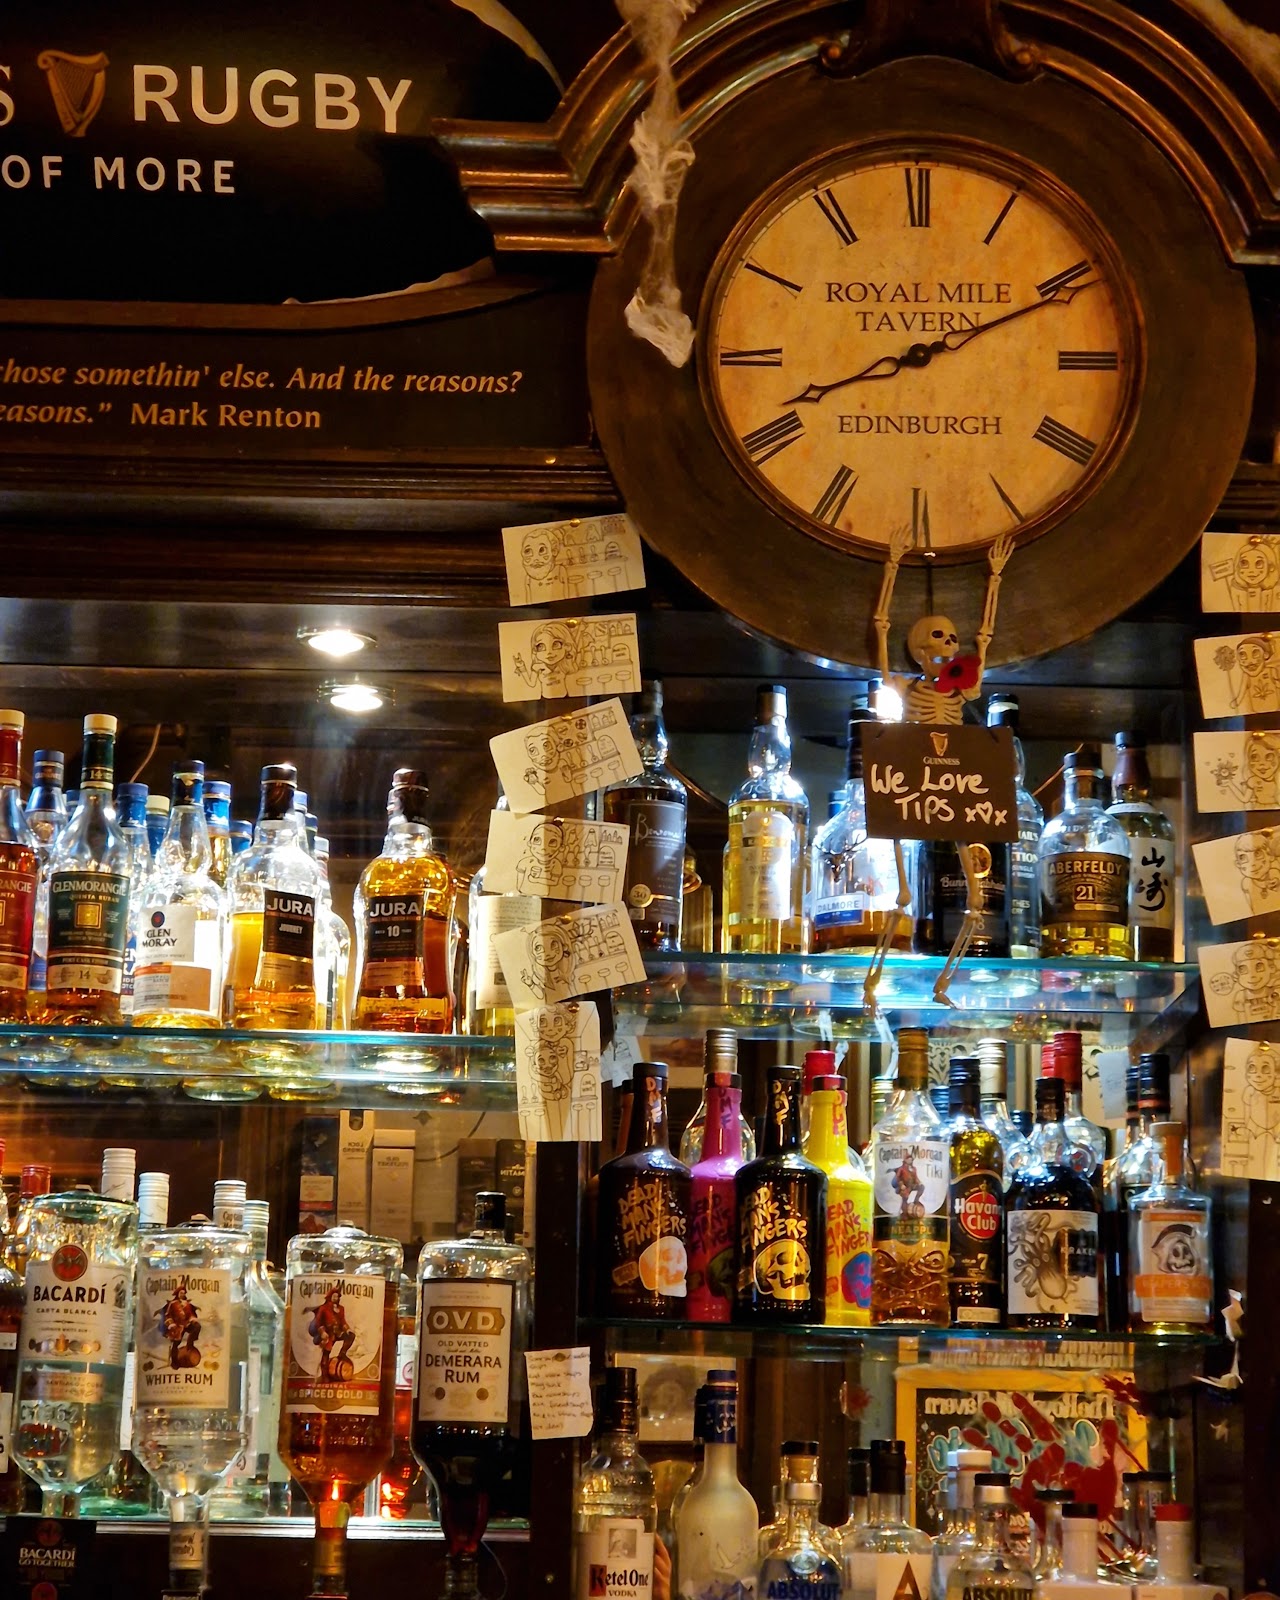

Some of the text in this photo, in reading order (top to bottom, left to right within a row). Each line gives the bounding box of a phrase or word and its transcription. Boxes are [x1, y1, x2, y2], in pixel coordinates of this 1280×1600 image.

[133, 64, 413, 134] RUGBY
[1, 154, 236, 194] OF MORE
[825, 281, 1013, 305] ROYAL MILE
[855, 311, 982, 333] TAVERN
[0, 358, 523, 395] hose somethin' else. And the reasons?
[131, 402, 208, 427] Mark
[218, 404, 322, 429] Renton
[837, 414, 1003, 436] EDINBURGH
[870, 763, 990, 795] We Love
[894, 791, 956, 825] TIPS
[1049, 860, 1122, 876] ABERFELDY
[53, 880, 128, 897] GLENMORANGIE
[1076, 885, 1096, 901] 21
[266, 898, 313, 917] JURA
[370, 901, 422, 917] JURA
[817, 899, 860, 914] DALMORE
[146, 928, 172, 939] GLEN
[387, 925, 400, 938] 10
[142, 937, 178, 949] MORAY
[79, 968, 91, 980] 14
[925, 1163, 944, 1179] Tiki
[966, 1214, 997, 1232] Club
[977, 1252, 989, 1271] 7
[33, 1284, 107, 1305] BACARDÍ
[299, 1279, 374, 1300] Captain Morgan
[64, 1308, 98, 1316] BLANCA
[432, 1311, 498, 1332] O.V.D.
[437, 1340, 490, 1348] OLD VATTED
[425, 1353, 502, 1369] DEMERARA
[146, 1373, 213, 1387] WHITE RUM
[444, 1369, 480, 1384] RUM
[298, 1388, 363, 1399] SPICED GOLD
[591, 1568, 650, 1587] Ketel One
[892, 1560, 923, 1600] A
[608, 1590, 638, 1598] VODKA
[766, 1581, 840, 1600] ABSOLUT
